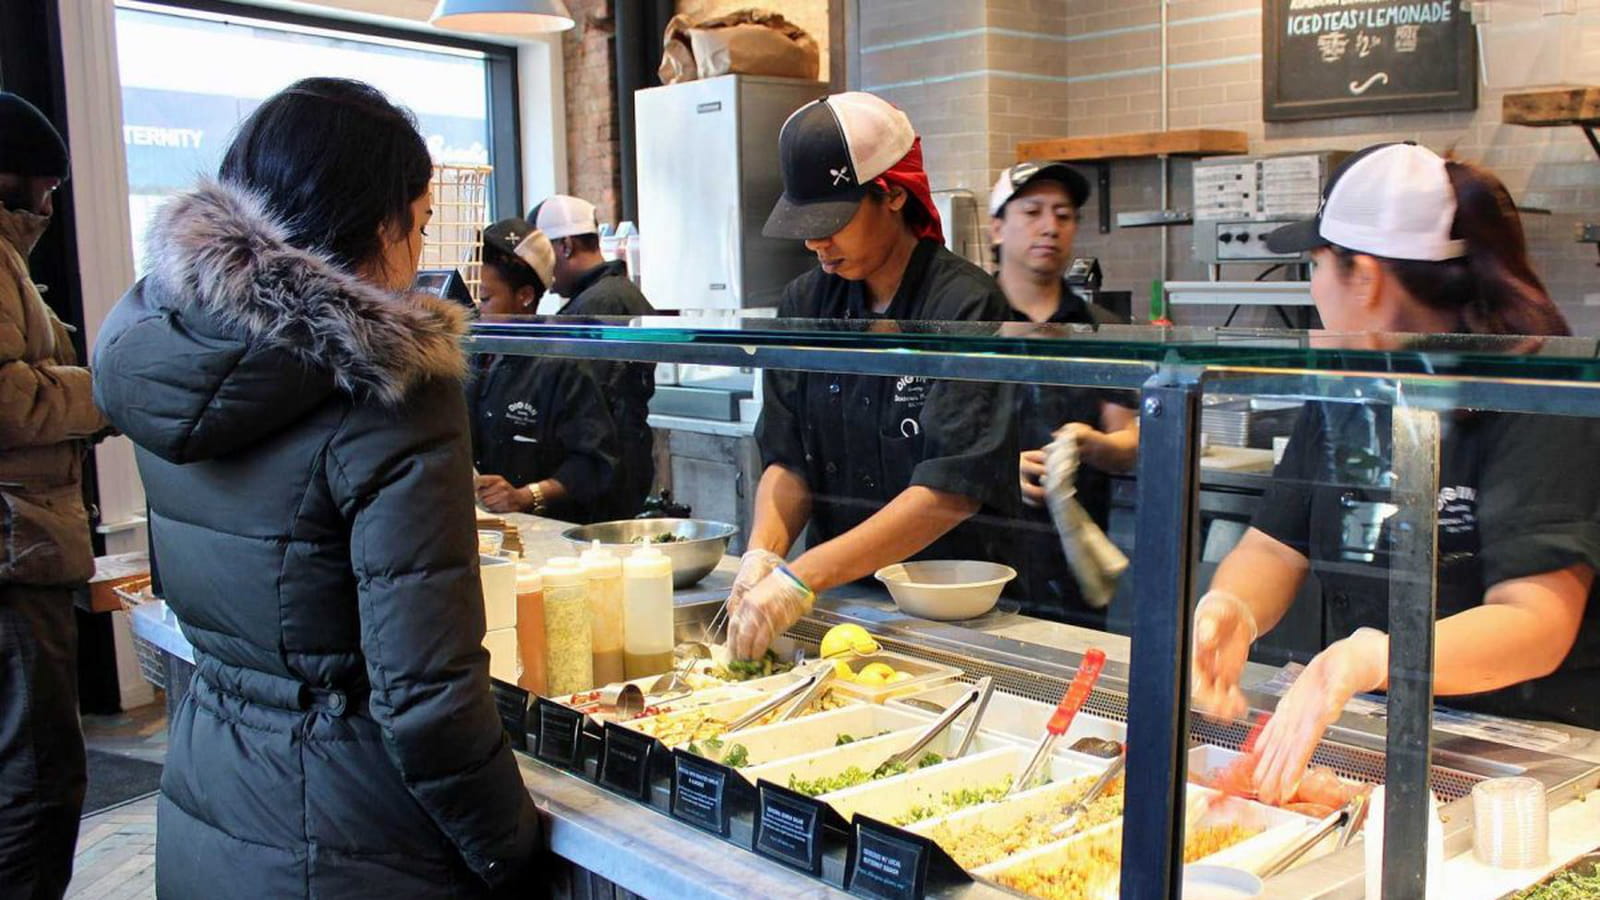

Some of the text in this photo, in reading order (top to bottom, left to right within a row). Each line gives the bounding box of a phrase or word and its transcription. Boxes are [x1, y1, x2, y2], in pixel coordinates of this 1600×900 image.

[1287, 14, 1322, 36] ICED
[1323, 9, 1358, 31] TEAS
[1366, 1, 1452, 28] LEMONADE
